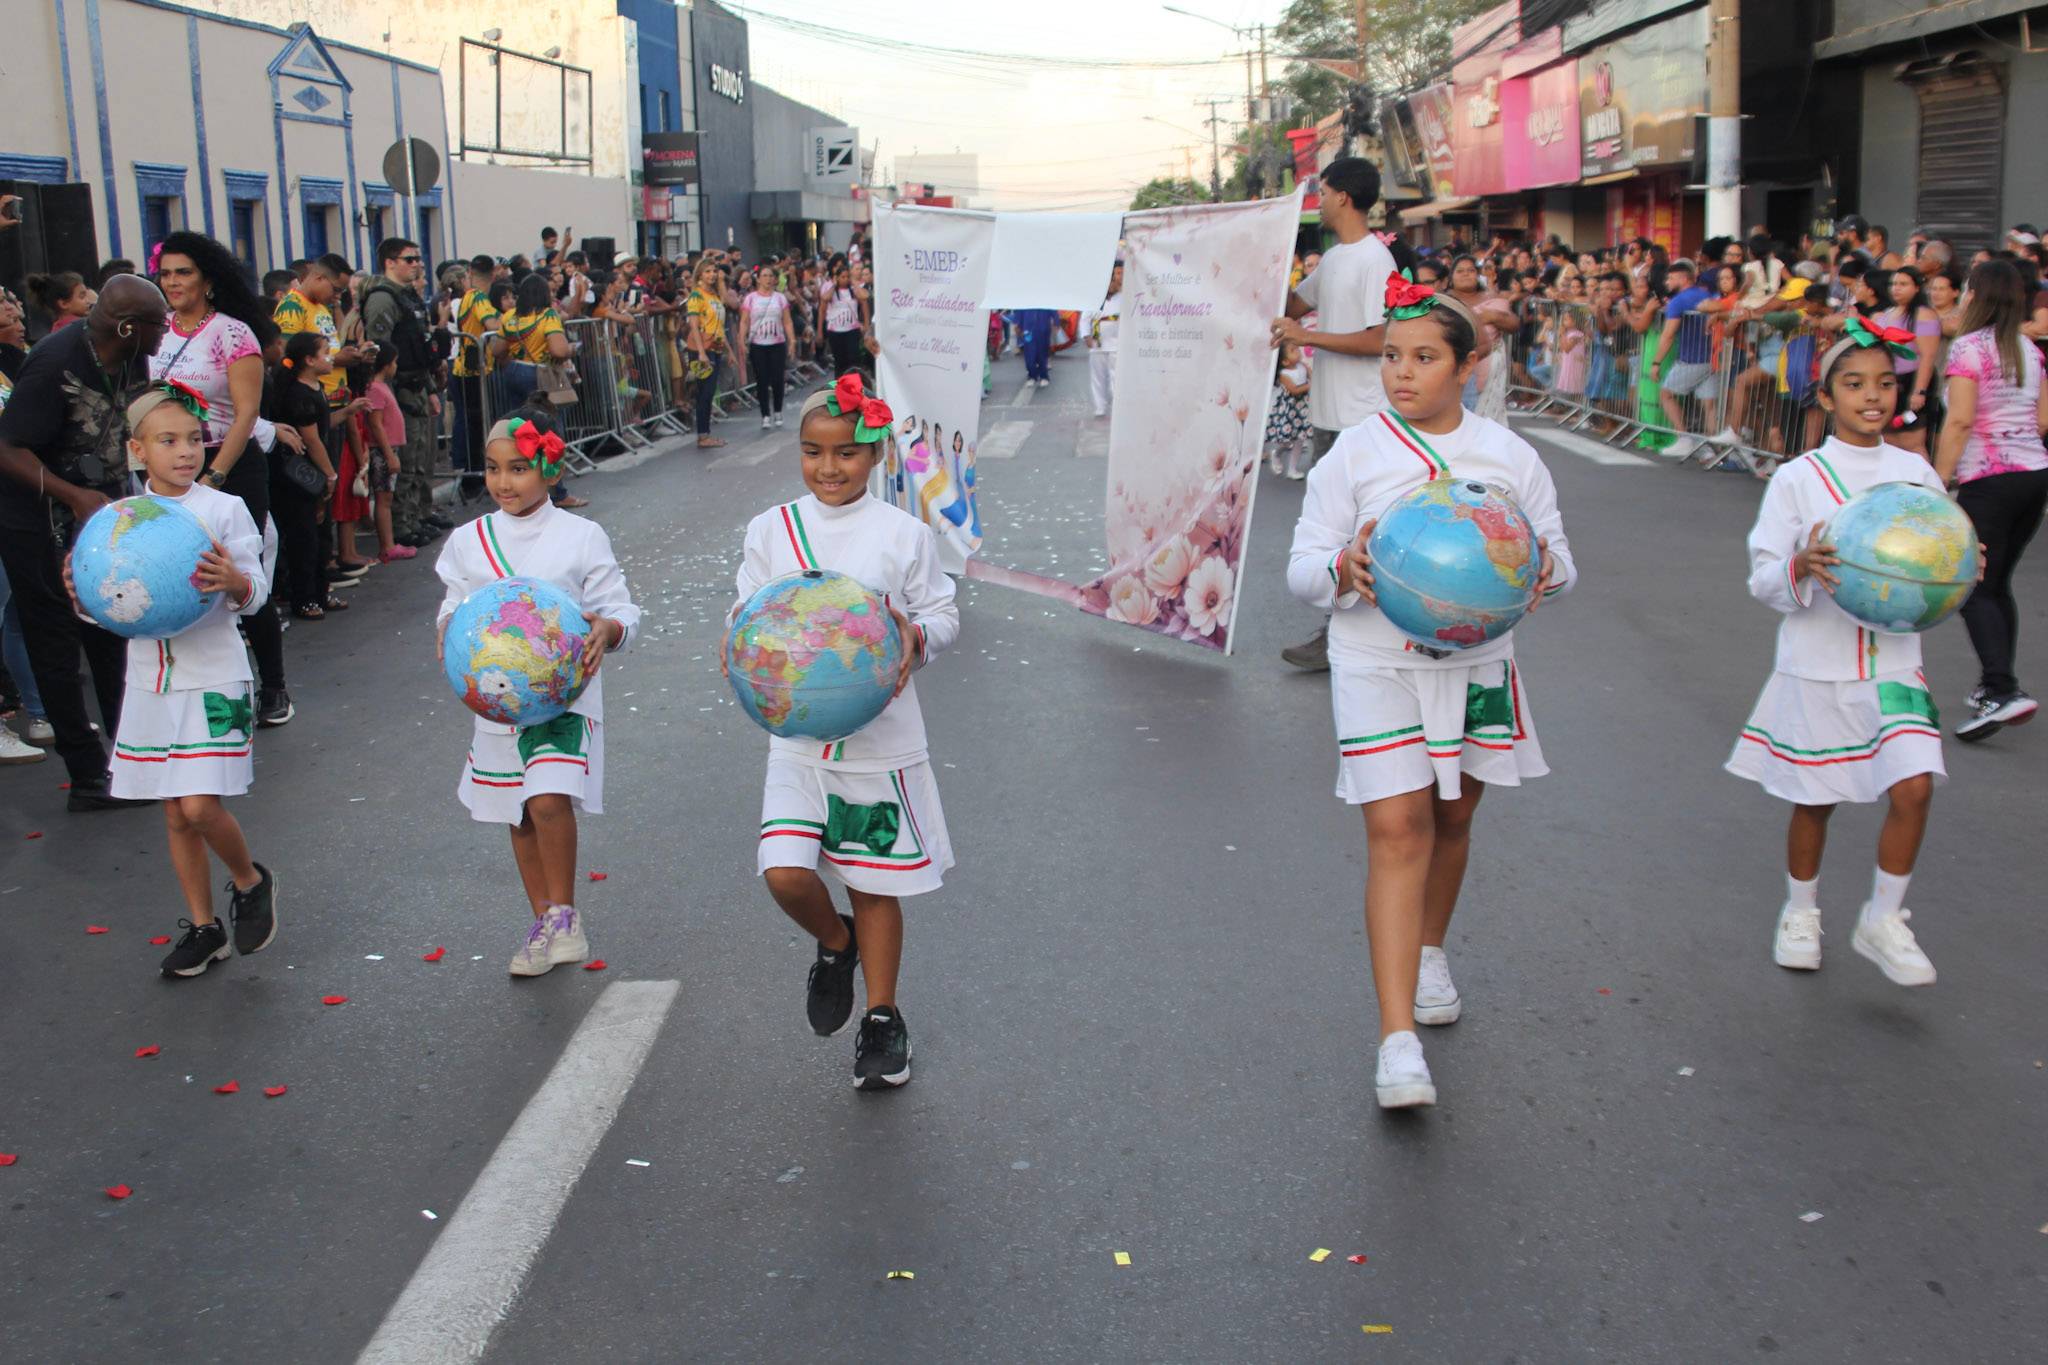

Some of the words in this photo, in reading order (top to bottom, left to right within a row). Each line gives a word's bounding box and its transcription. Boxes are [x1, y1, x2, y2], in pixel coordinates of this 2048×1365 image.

[711, 63, 738, 101] STUDIO
[656, 150, 696, 160] MORENA
[816, 136, 824, 176] STUDIO
[914, 249, 959, 272] EMEB
[890, 287, 915, 308] Rita
[1130, 291, 1213, 325] Transformar
